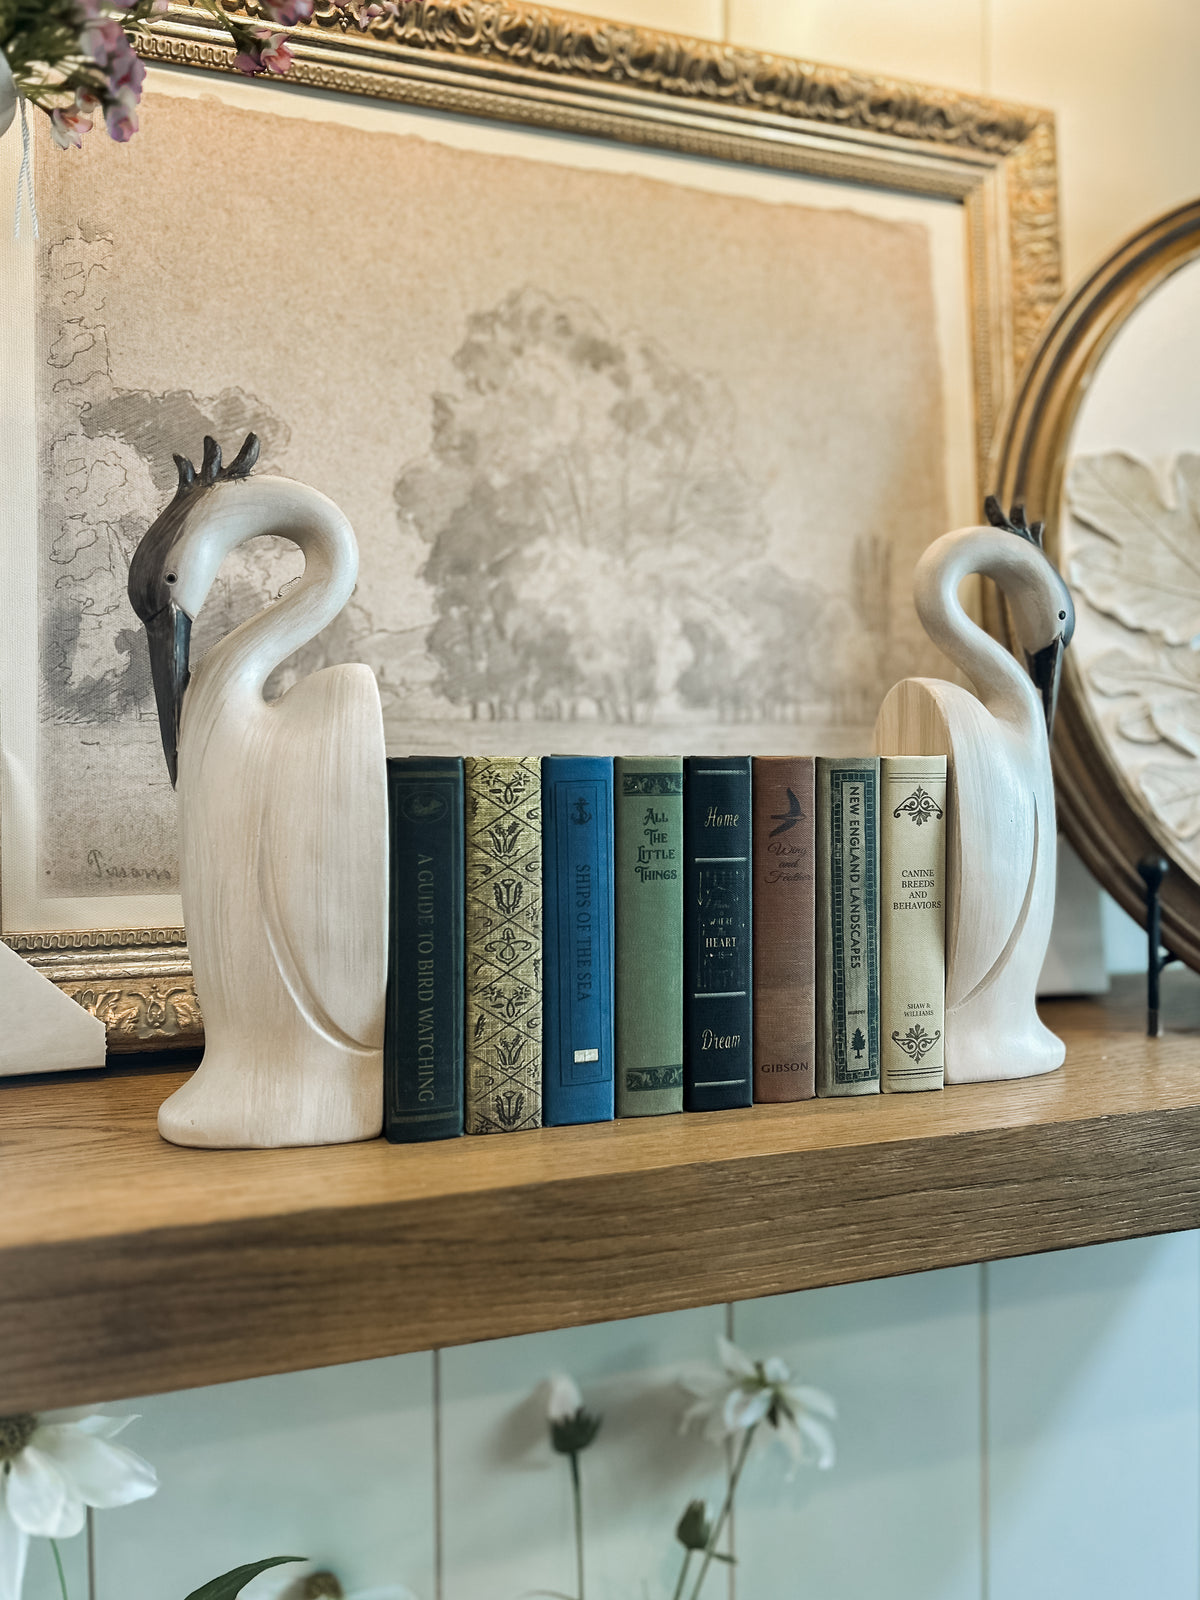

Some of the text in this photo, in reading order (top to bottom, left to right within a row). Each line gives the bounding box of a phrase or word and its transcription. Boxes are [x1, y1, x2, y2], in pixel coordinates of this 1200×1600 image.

[704, 806, 739, 828] Home
[778, 858, 800, 869] and
[848, 786, 862, 969] NEW ENGLAND LANDSCAPES
[901, 869, 935, 878] CANINE
[901, 879, 935, 889] BREEDS
[908, 890, 928, 899] AND
[893, 900, 942, 910] BEHAVIORS
[576, 864, 592, 1002] SHIPS OF THE SEA
[705, 936, 737, 948] HEART
[417, 853, 434, 1102] A GUIDE TO BIRD WATCHING
[701, 1028, 741, 1050] Dream
[761, 1062, 809, 1073] GIBSON
